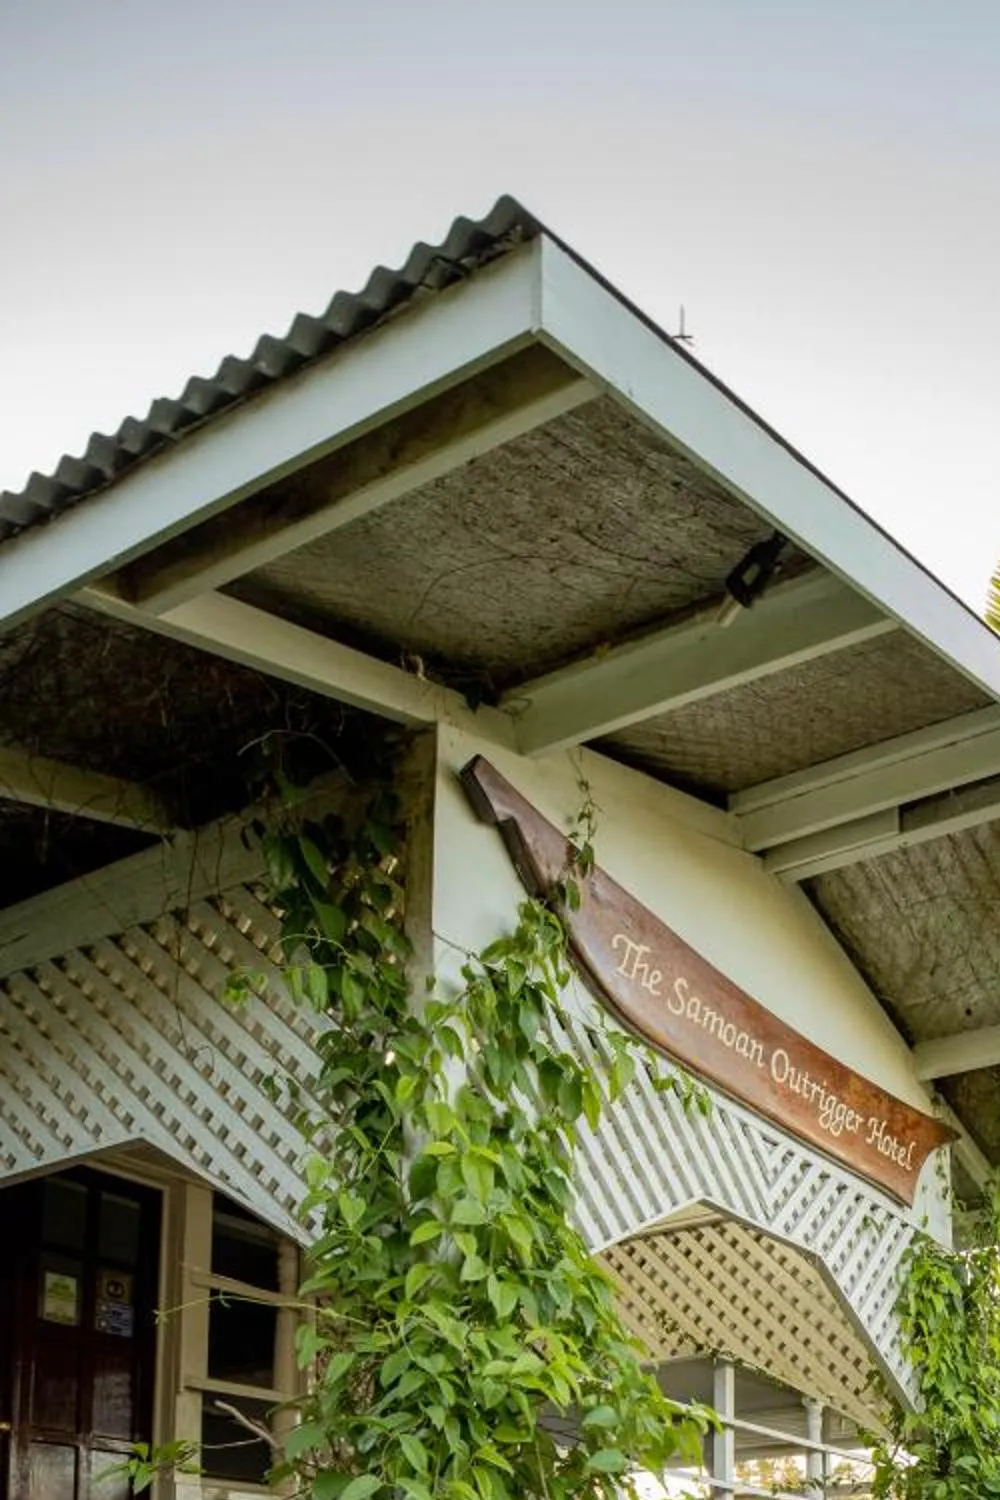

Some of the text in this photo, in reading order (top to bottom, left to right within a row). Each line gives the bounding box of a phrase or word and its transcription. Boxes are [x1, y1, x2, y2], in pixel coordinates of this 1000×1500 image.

[611, 933, 915, 1171] The Samoan Outrigger Hotel
